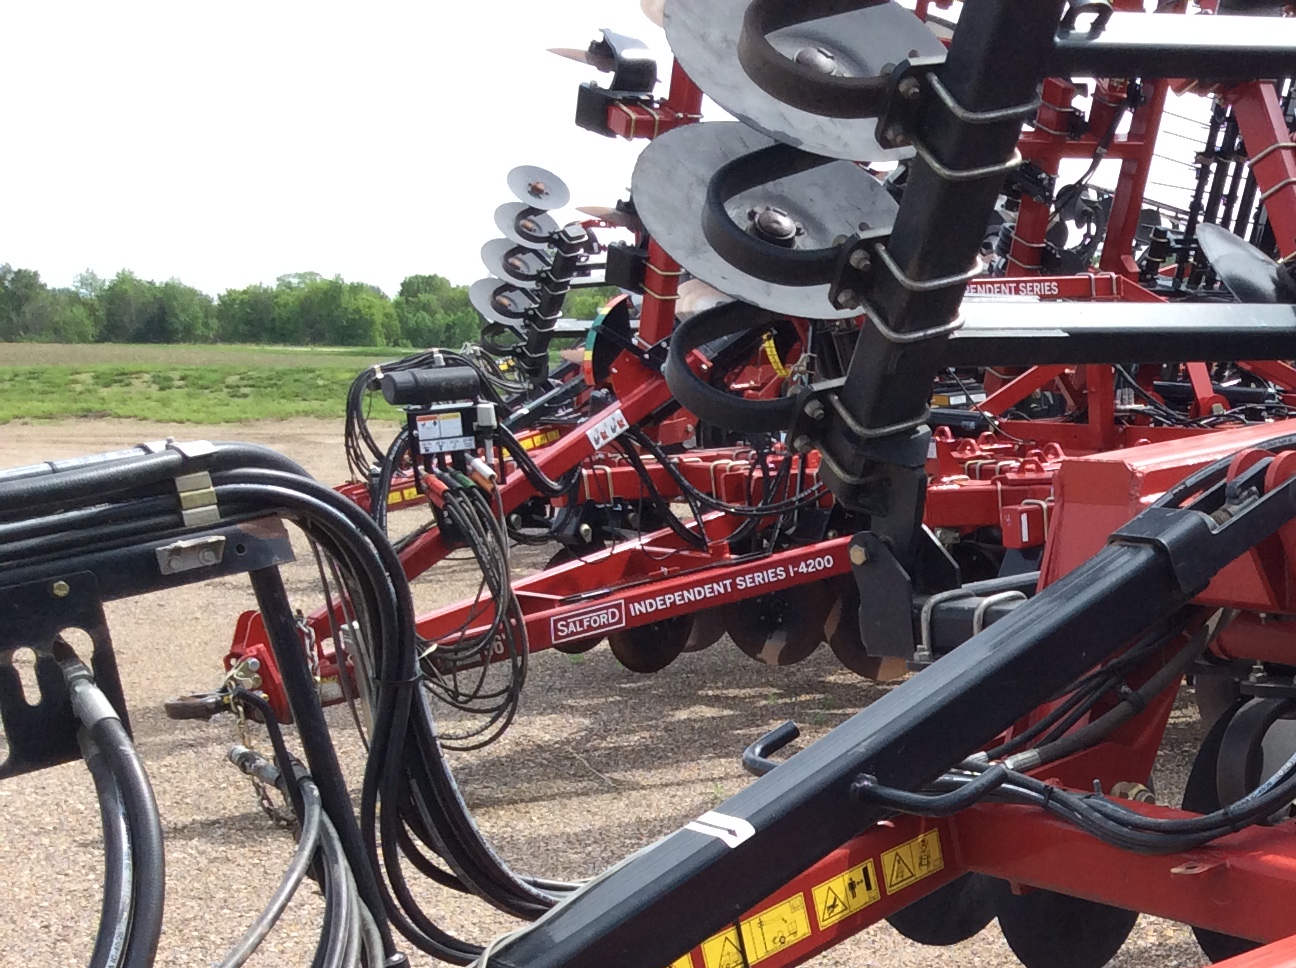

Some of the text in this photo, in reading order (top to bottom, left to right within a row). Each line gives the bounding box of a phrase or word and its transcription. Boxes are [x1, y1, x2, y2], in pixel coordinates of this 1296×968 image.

[1018, 281, 1059, 295] SERIES
[557, 555, 835, 636] SALFORD INDEPENDENT SERIES I-4200
